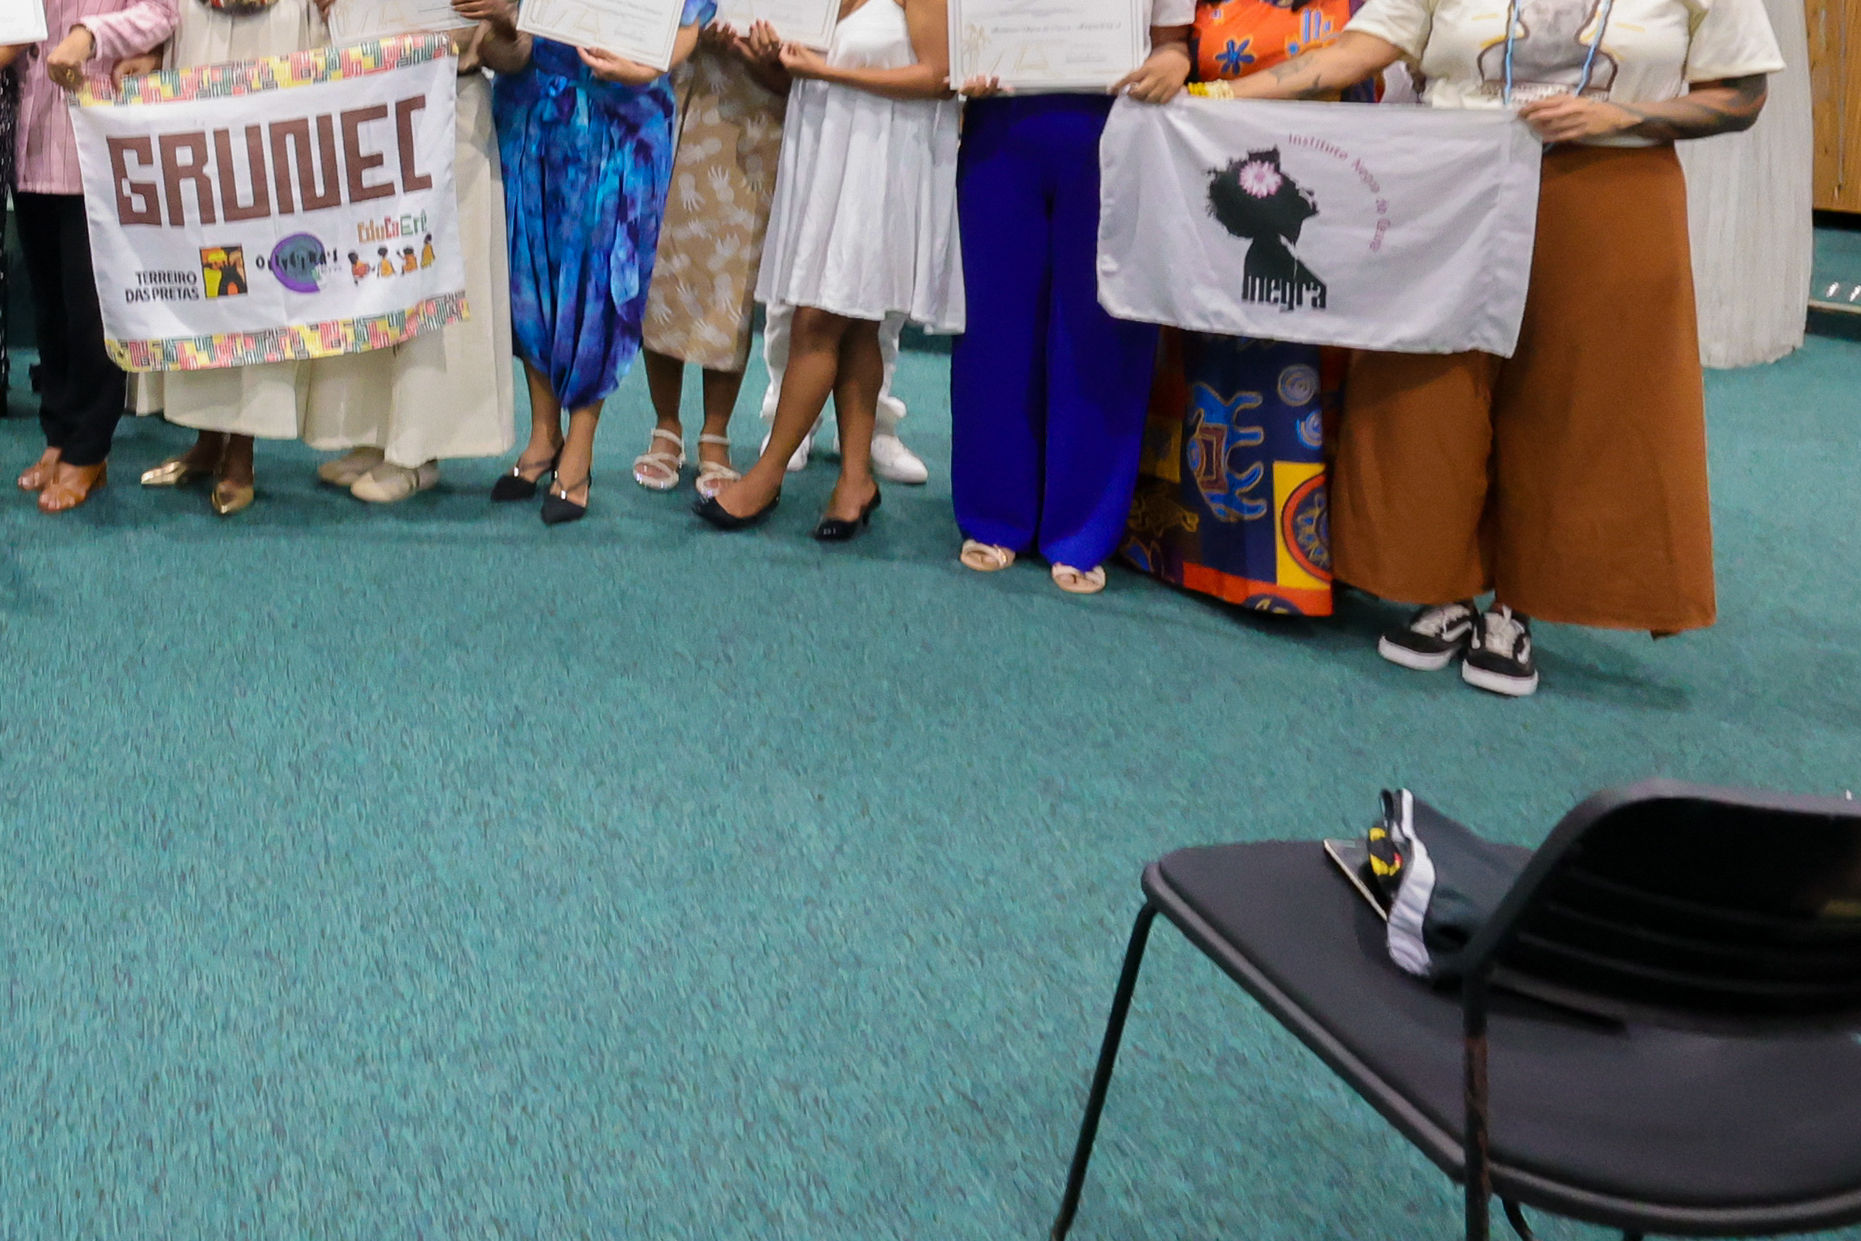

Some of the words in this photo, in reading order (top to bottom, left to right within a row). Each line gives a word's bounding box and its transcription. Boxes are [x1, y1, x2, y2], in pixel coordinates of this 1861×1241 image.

[106, 94, 432, 227] GRUNEC
[135, 269, 198, 286] TERREIRO
[125, 288, 151, 304] DAS
[152, 286, 200, 302] PRETAS
